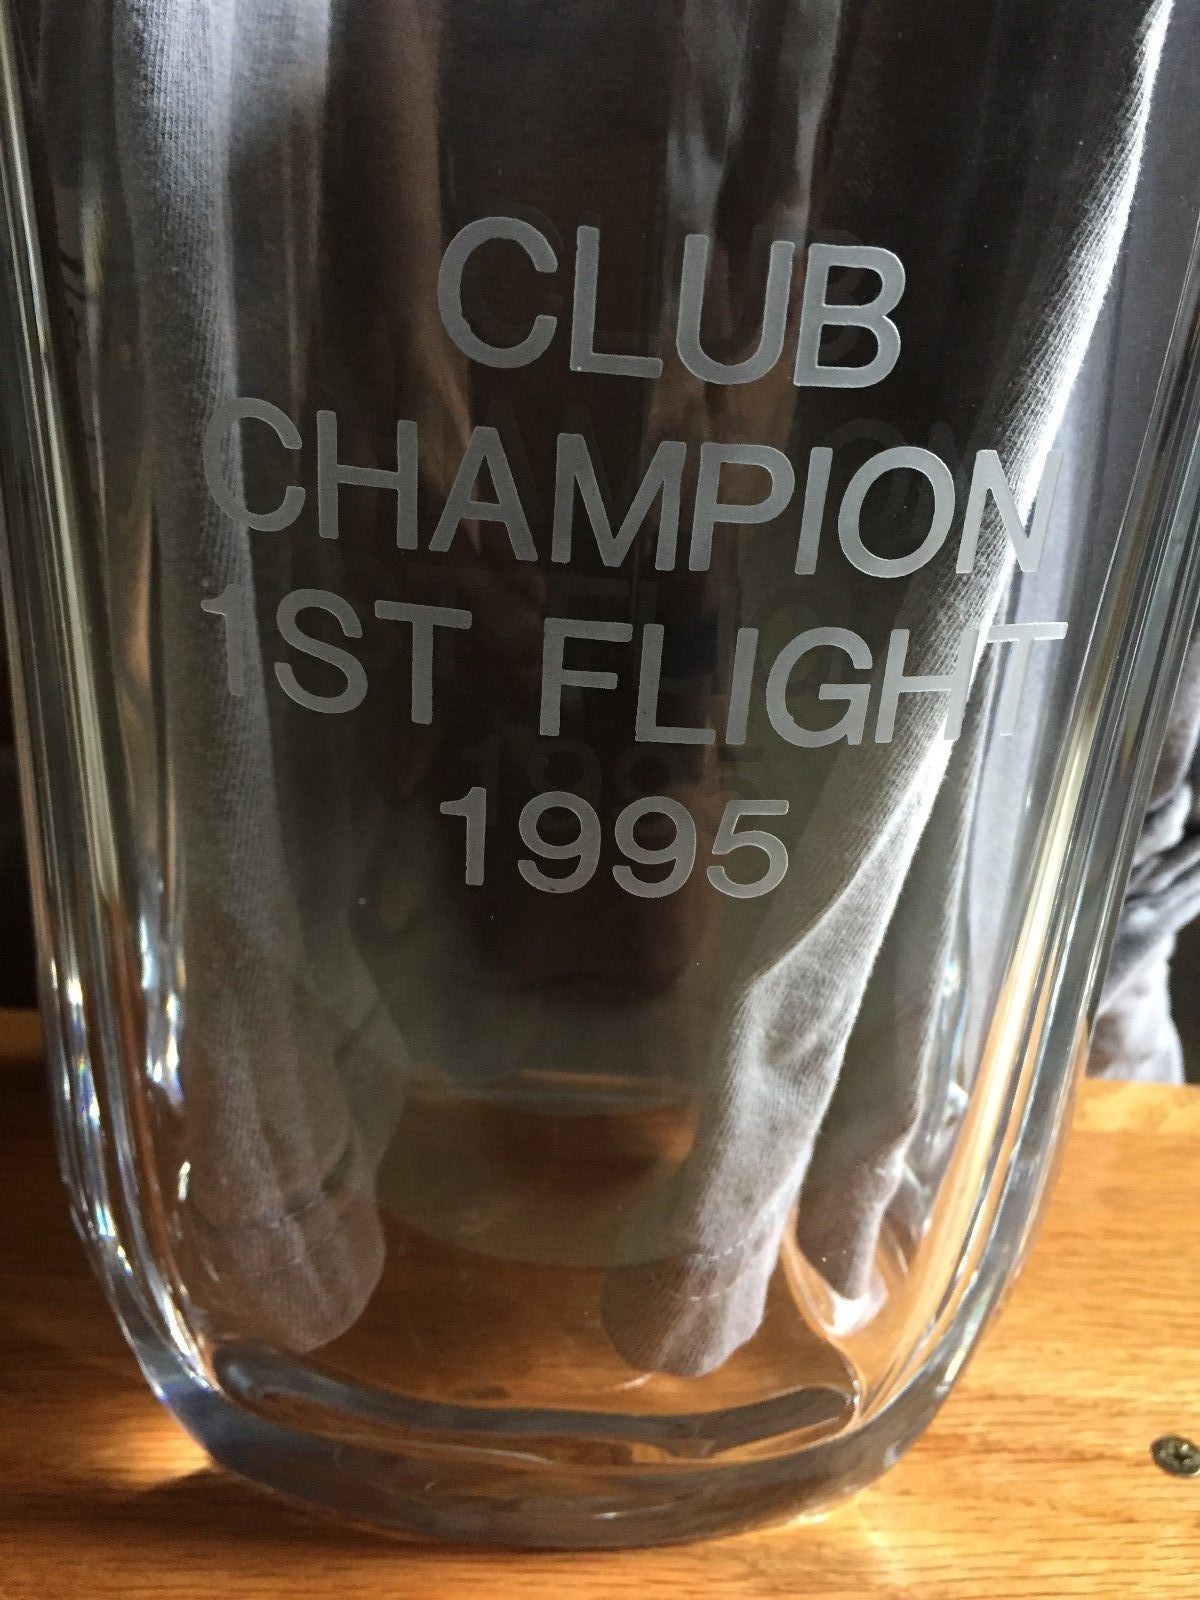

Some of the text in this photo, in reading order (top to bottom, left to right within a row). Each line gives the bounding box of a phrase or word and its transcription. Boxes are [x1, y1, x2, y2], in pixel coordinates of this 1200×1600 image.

[437, 215, 906, 388] CLUB
[203, 397, 1063, 578] CHAMPION
[200, 585, 1068, 748] 1ST FLIGHT
[440, 787, 789, 899] 1995
